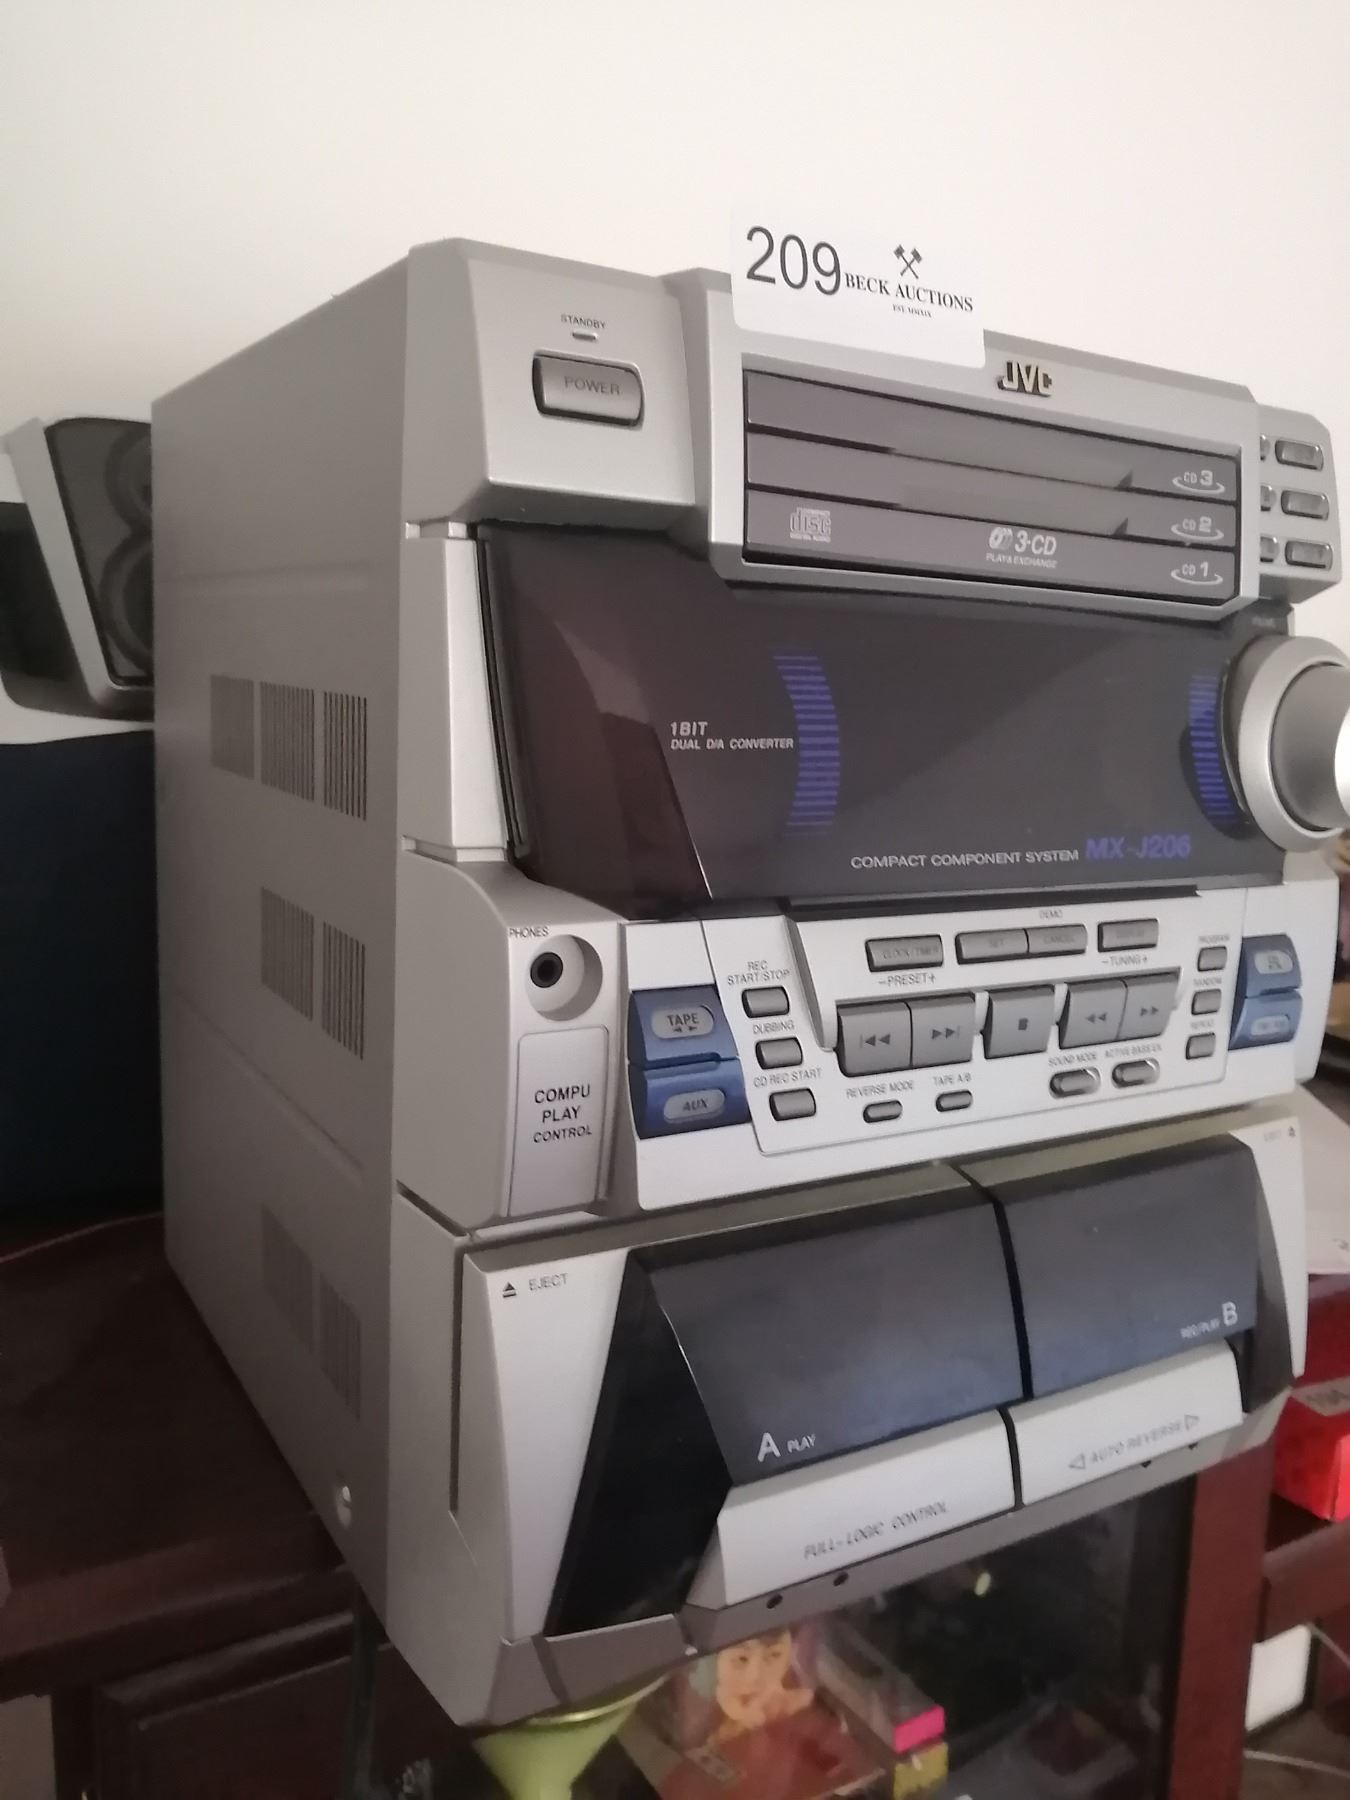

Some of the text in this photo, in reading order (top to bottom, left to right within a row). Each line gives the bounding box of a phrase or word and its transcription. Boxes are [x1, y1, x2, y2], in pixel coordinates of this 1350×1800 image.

[746, 225, 842, 296] 209
[844, 272, 974, 313] BECK AUCTIONS
[560, 314, 606, 329] STANDBY
[563, 376, 621, 396] POWER
[998, 359, 1053, 398] JVC
[1183, 469, 1213, 486] CD 3
[1182, 516, 1212, 533] CD 2
[1182, 561, 1209, 577] CD 1
[670, 739, 701, 750] DUAL
[729, 737, 795, 750] CONVERTER
[850, 834, 1192, 870] COMPACT COMPONENT SYSTEM MX-J206
[1039, 909, 1063, 919] DEMO
[509, 925, 549, 939] PHONES
[747, 960, 769, 972] REC
[667, 1013, 700, 1027] TAPE
[753, 1020, 796, 1035] DUBBING
[753, 1067, 823, 1088] CD REC START
[932, 1074, 953, 1087] TAPE
[534, 1083, 591, 1105] COMPU
[846, 1080, 914, 1099] REVERSE MODE
[541, 1105, 581, 1124] PLAY
[682, 1098, 708, 1112] AUX
[533, 1124, 593, 1144] CONTROL
[529, 1272, 568, 1291] EJECT
[1221, 1301, 1238, 1327] B
[757, 1432, 816, 1463] A PLAY
[1091, 1420, 1182, 1464] AUTO REVERSE
[890, 1501, 949, 1531] CONTROL
